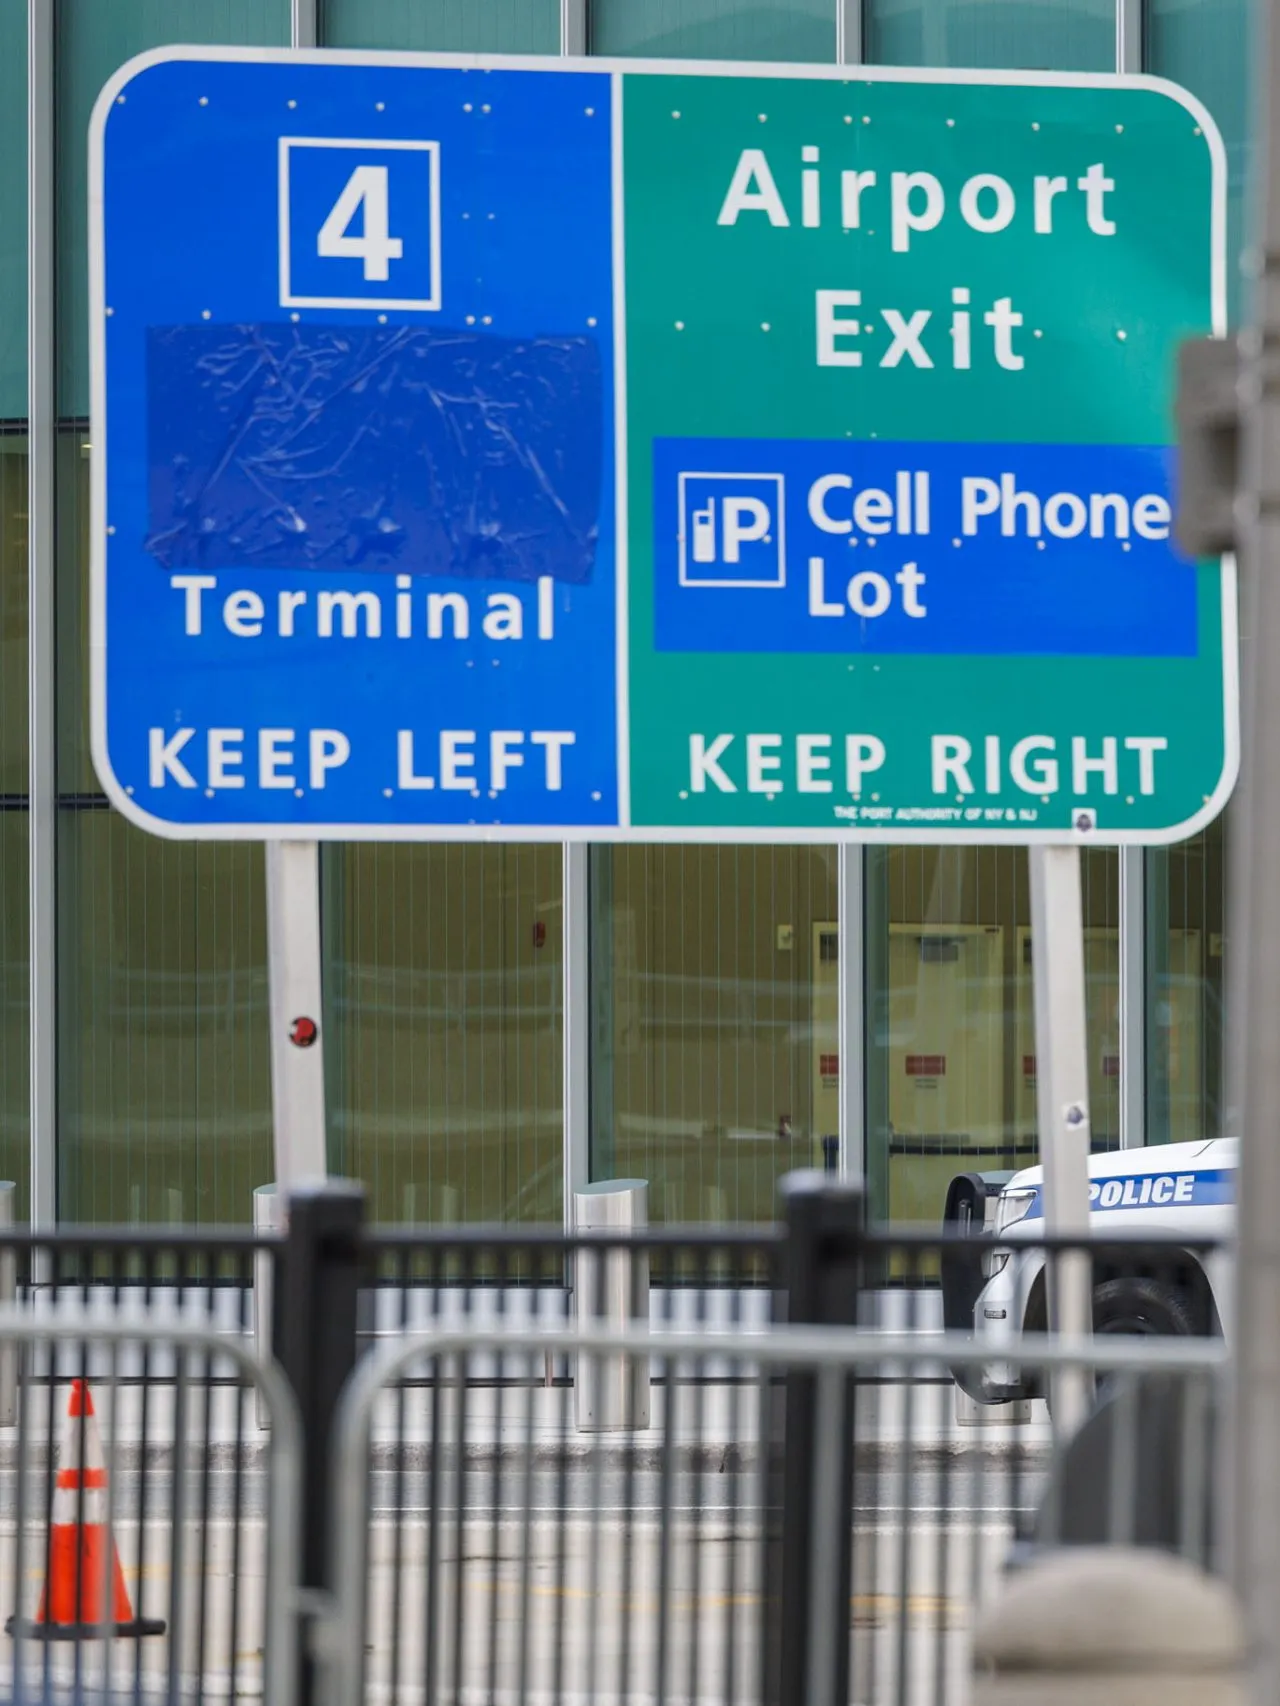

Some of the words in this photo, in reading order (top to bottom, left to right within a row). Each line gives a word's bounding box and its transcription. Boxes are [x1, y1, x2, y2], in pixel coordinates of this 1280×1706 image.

[317, 166, 403, 281] 4
[717, 145, 1116, 252] Airport
[815, 287, 1025, 371] Exit
[808, 471, 930, 535] Cell
[961, 473, 1172, 540] Phone
[171, 574, 553, 640] Terminal
[809, 557, 926, 618] Lot
[148, 728, 351, 789] KEEP
[398, 730, 576, 791] LEFT
[689, 734, 886, 793] KEEP
[931, 735, 1168, 796] RIGHT
[834, 806, 857, 820] THE
[860, 806, 892, 820] PORT
[895, 807, 962, 821] AUTHORITY
[964, 808, 982, 821] OF
